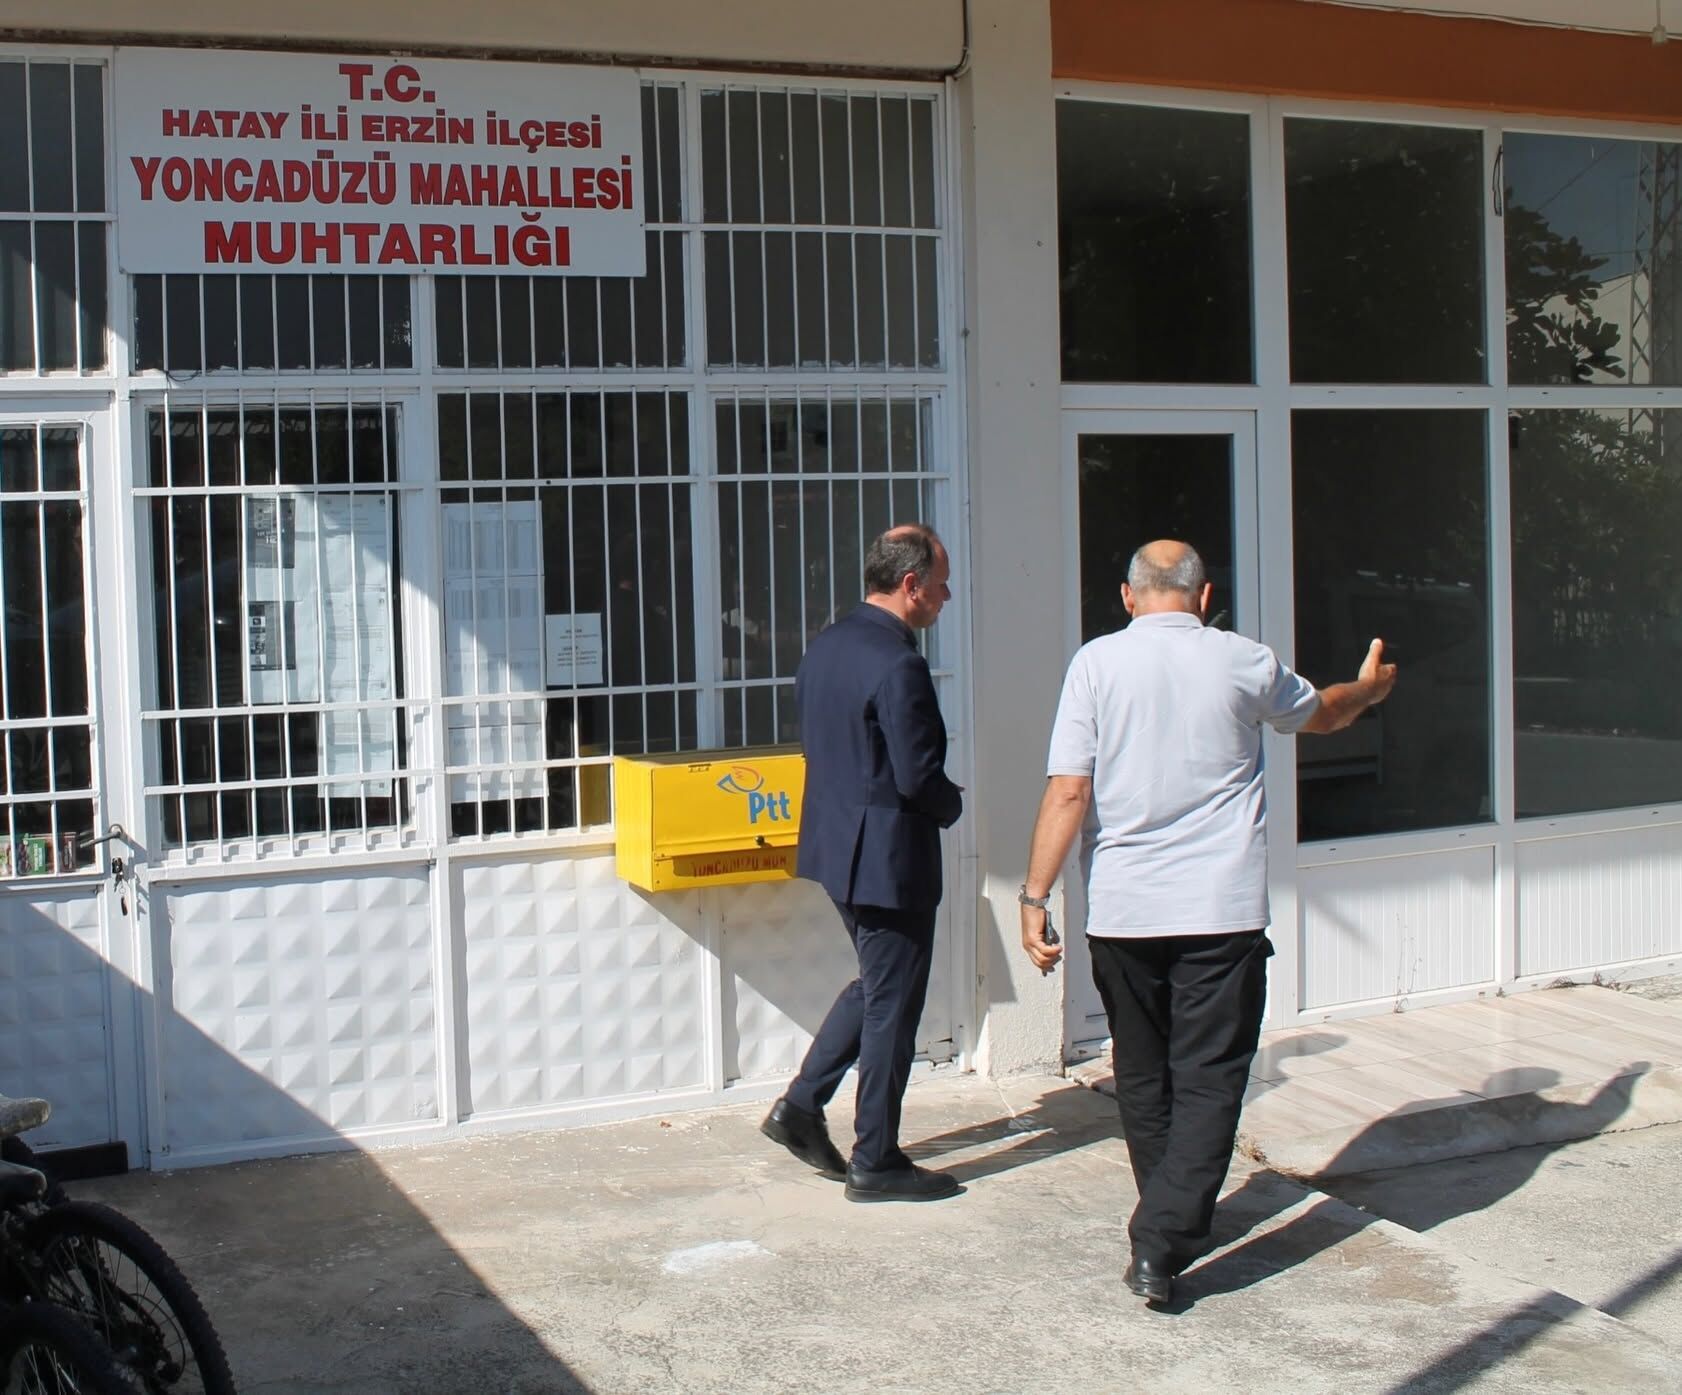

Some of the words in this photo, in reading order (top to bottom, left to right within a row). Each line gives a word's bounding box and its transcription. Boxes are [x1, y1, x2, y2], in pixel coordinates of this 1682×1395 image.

[339, 63, 435, 102] T.C.
[162, 109, 289, 139] HATAY
[301, 104, 348, 141] İLİ
[361, 109, 474, 145] ERZİN
[486, 111, 602, 153] İLÇESİ
[130, 149, 396, 204] YONCADÜZÜ
[409, 155, 633, 210] MAHALLESİ
[204, 211, 571, 267] MUHTARLIĞI
[748, 791, 792, 824] Ptt
